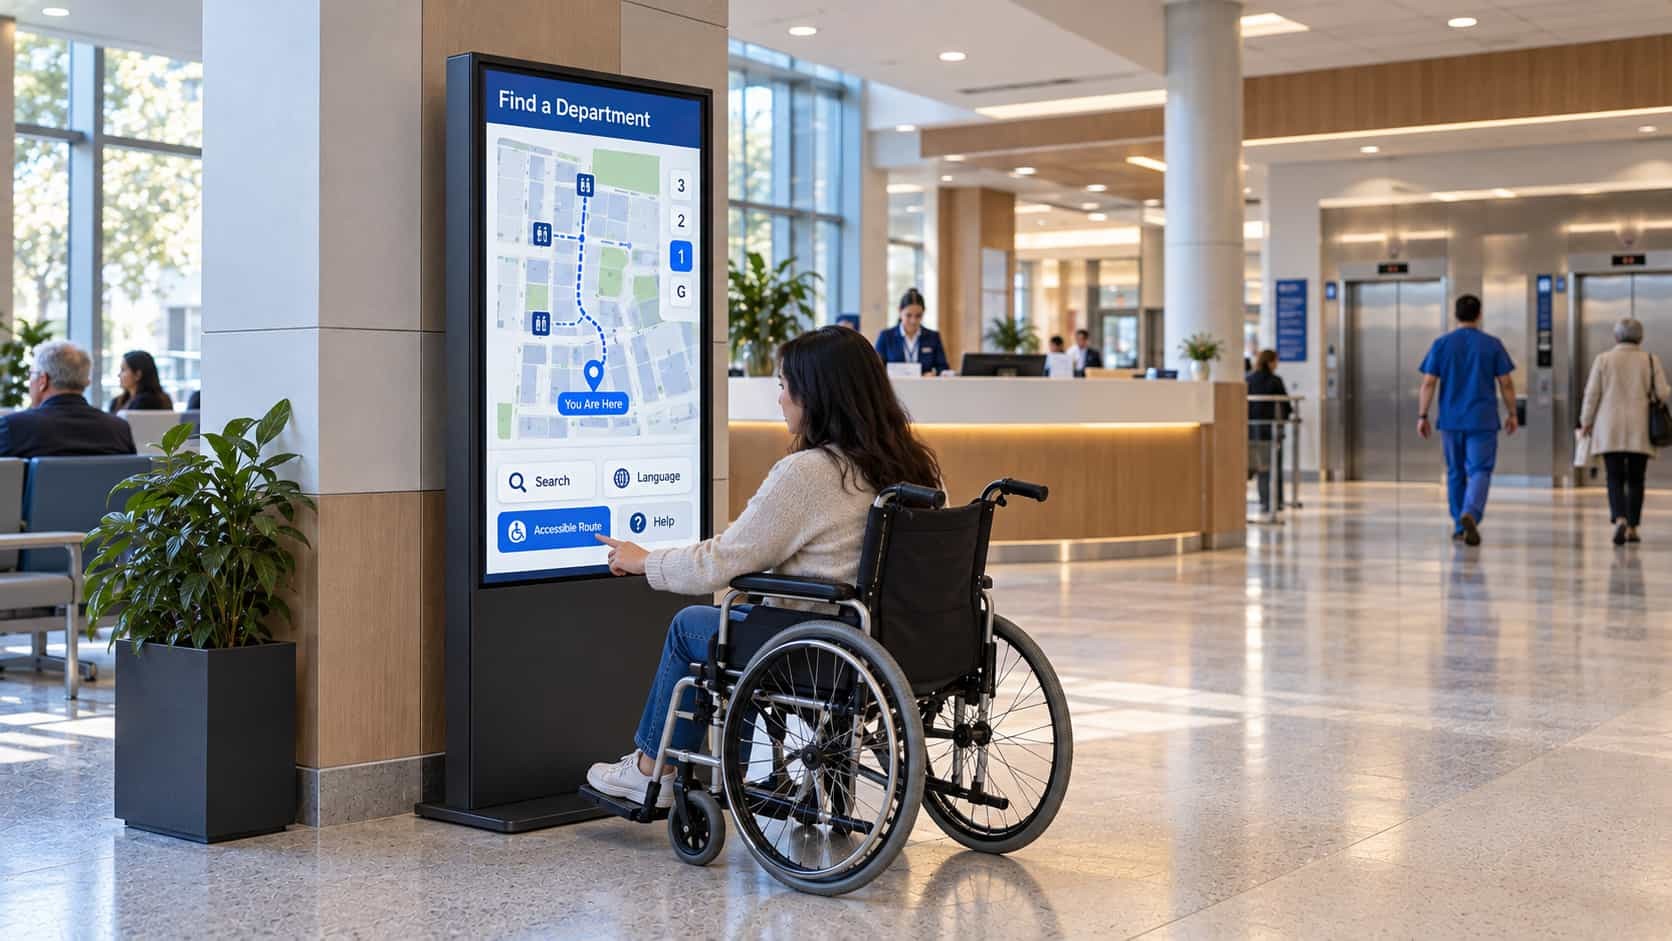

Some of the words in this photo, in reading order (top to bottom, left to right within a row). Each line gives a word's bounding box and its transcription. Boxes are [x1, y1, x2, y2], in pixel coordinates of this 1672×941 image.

[499, 89, 537, 113] Find
[541, 102, 551, 114] a
[556, 98, 651, 128] Department
[677, 178, 686, 193] 3
[677, 214, 686, 228] 2
[678, 250, 685, 264] 1
[677, 285, 686, 298] G
[565, 399, 582, 410] You
[584, 399, 600, 409] Are
[602, 399, 623, 409] Here
[535, 475, 570, 488] Search
[637, 471, 681, 485] Language
[534, 522, 577, 536] Accessible
[578, 521, 602, 533] Route
[653, 515, 675, 529] Help
